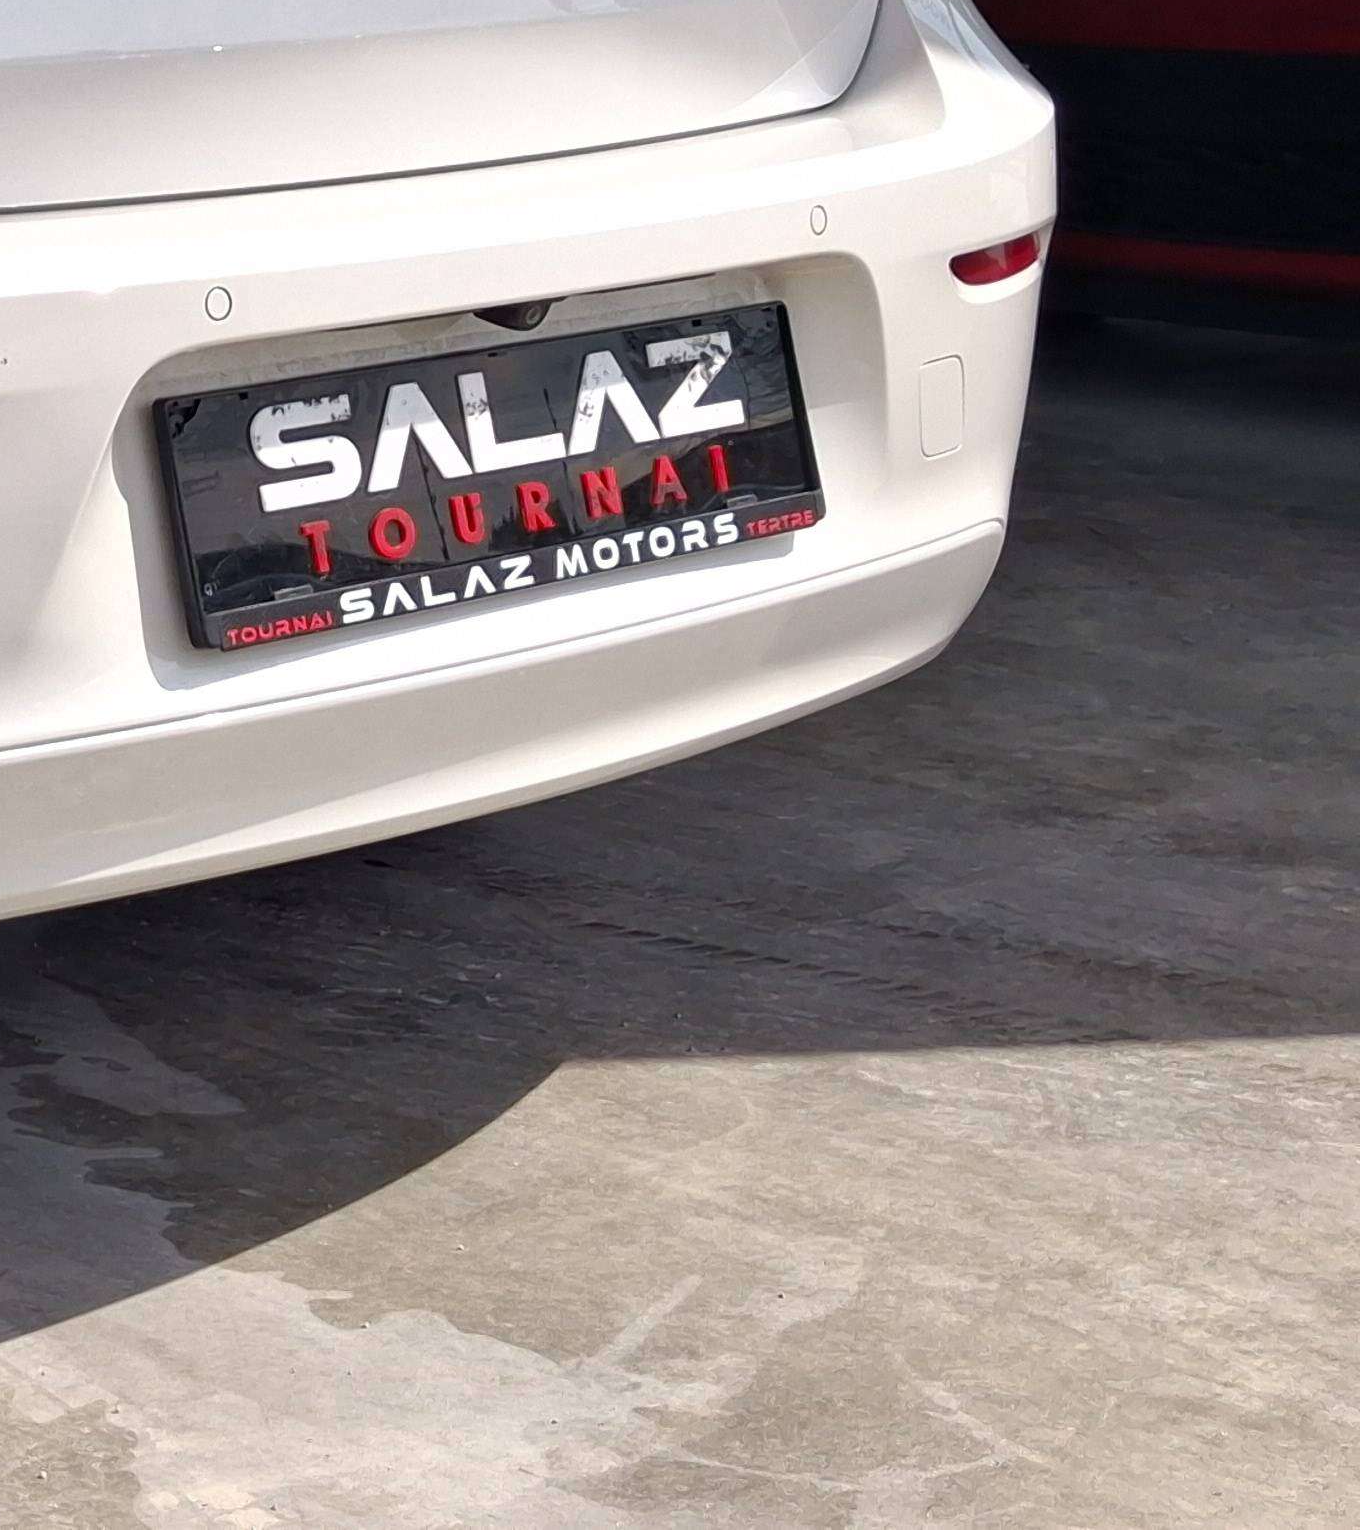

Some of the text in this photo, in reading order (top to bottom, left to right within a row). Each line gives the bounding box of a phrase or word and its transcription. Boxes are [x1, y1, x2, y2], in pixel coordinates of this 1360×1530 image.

[249, 331, 746, 513] SALAZ
[226, 509, 815, 646] TOURNAI SALAZ MOTORS TERTRE
[300, 444, 730, 575] TOURNAI
